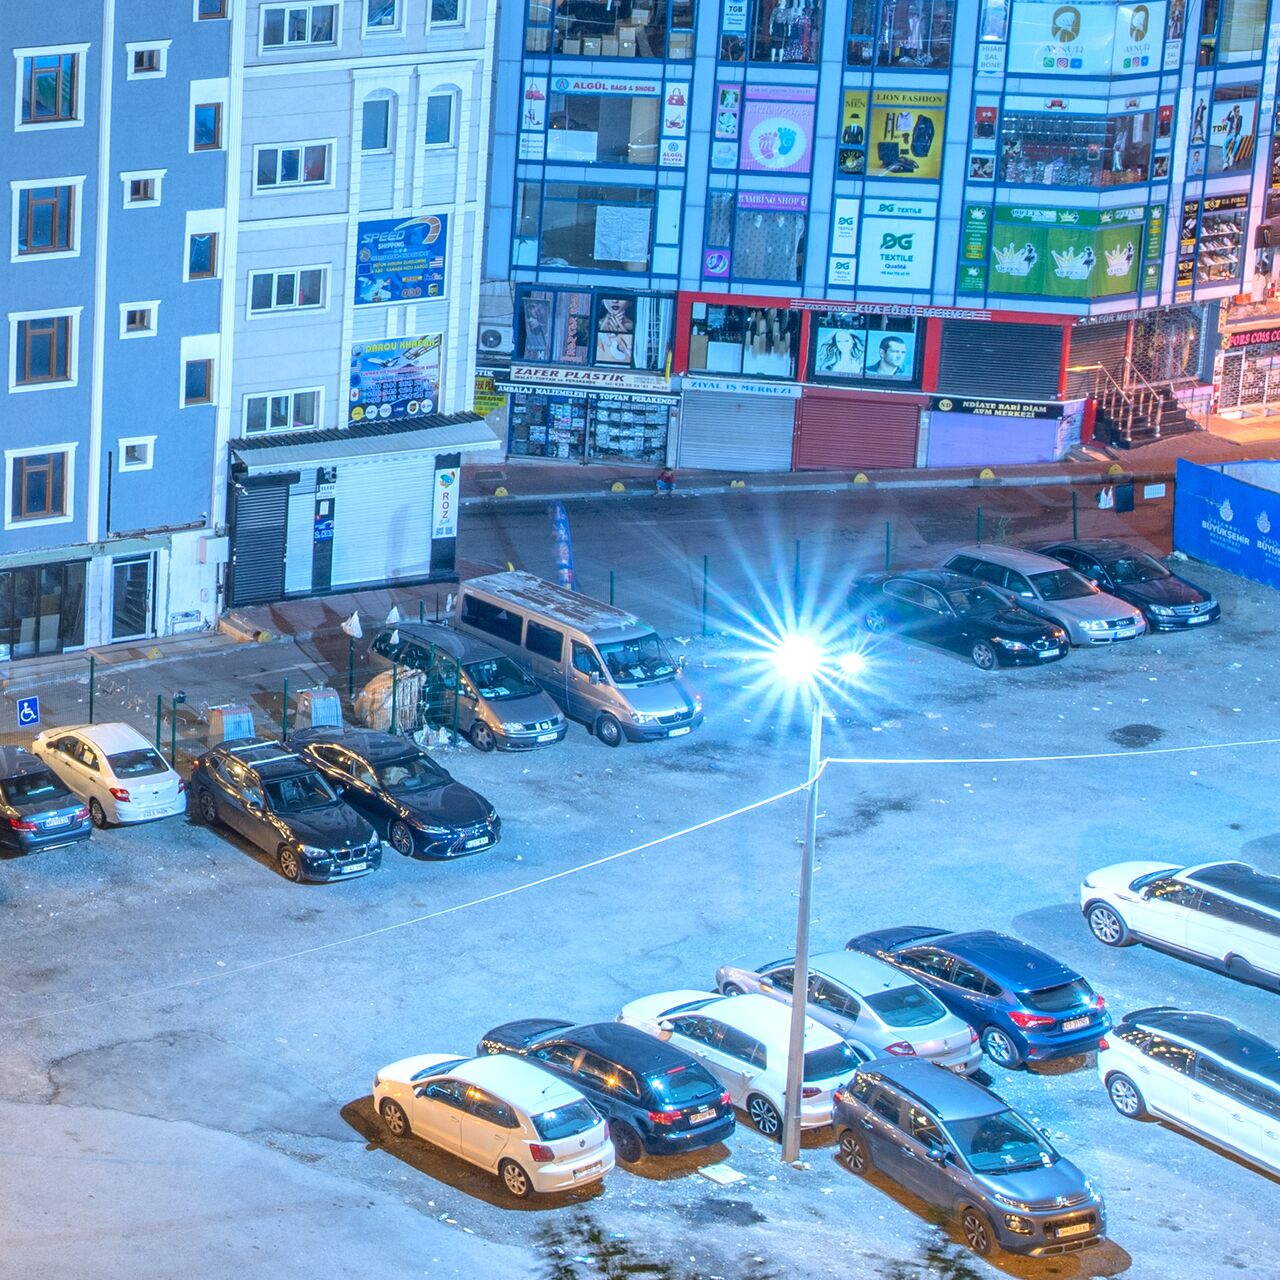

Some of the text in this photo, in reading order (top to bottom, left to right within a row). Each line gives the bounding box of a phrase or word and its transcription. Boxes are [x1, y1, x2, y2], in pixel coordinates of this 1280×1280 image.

[573, 80, 608, 90] ALGÜL
[876, 93, 943, 103] LION FASHION
[777, 196, 800, 205] SHOP
[361, 230, 405, 244] SPEED
[378, 241, 404, 250] SHIPPING
[880, 253, 913, 262] TEXTILE
[923, 308, 977, 320] MEHMET
[514, 367, 625, 382] ZAFER PLASTİK
[742, 384, 791, 394] MERKEZİ
[497, 385, 533, 394] AMBALAJ
[536, 387, 587, 399] MALZEMELERİ
[599, 393, 628, 402] TOPTAN
[631, 395, 677, 406] PERAKENDE
[963, 401, 998, 410] NDİAYE
[999, 402, 1021, 411] BARİ
[973, 408, 1035, 418] AVM MERKEZİ
[442, 492, 450, 519] ROZ
[1202, 520, 1250, 546] BÜYÜKŞEHİR
